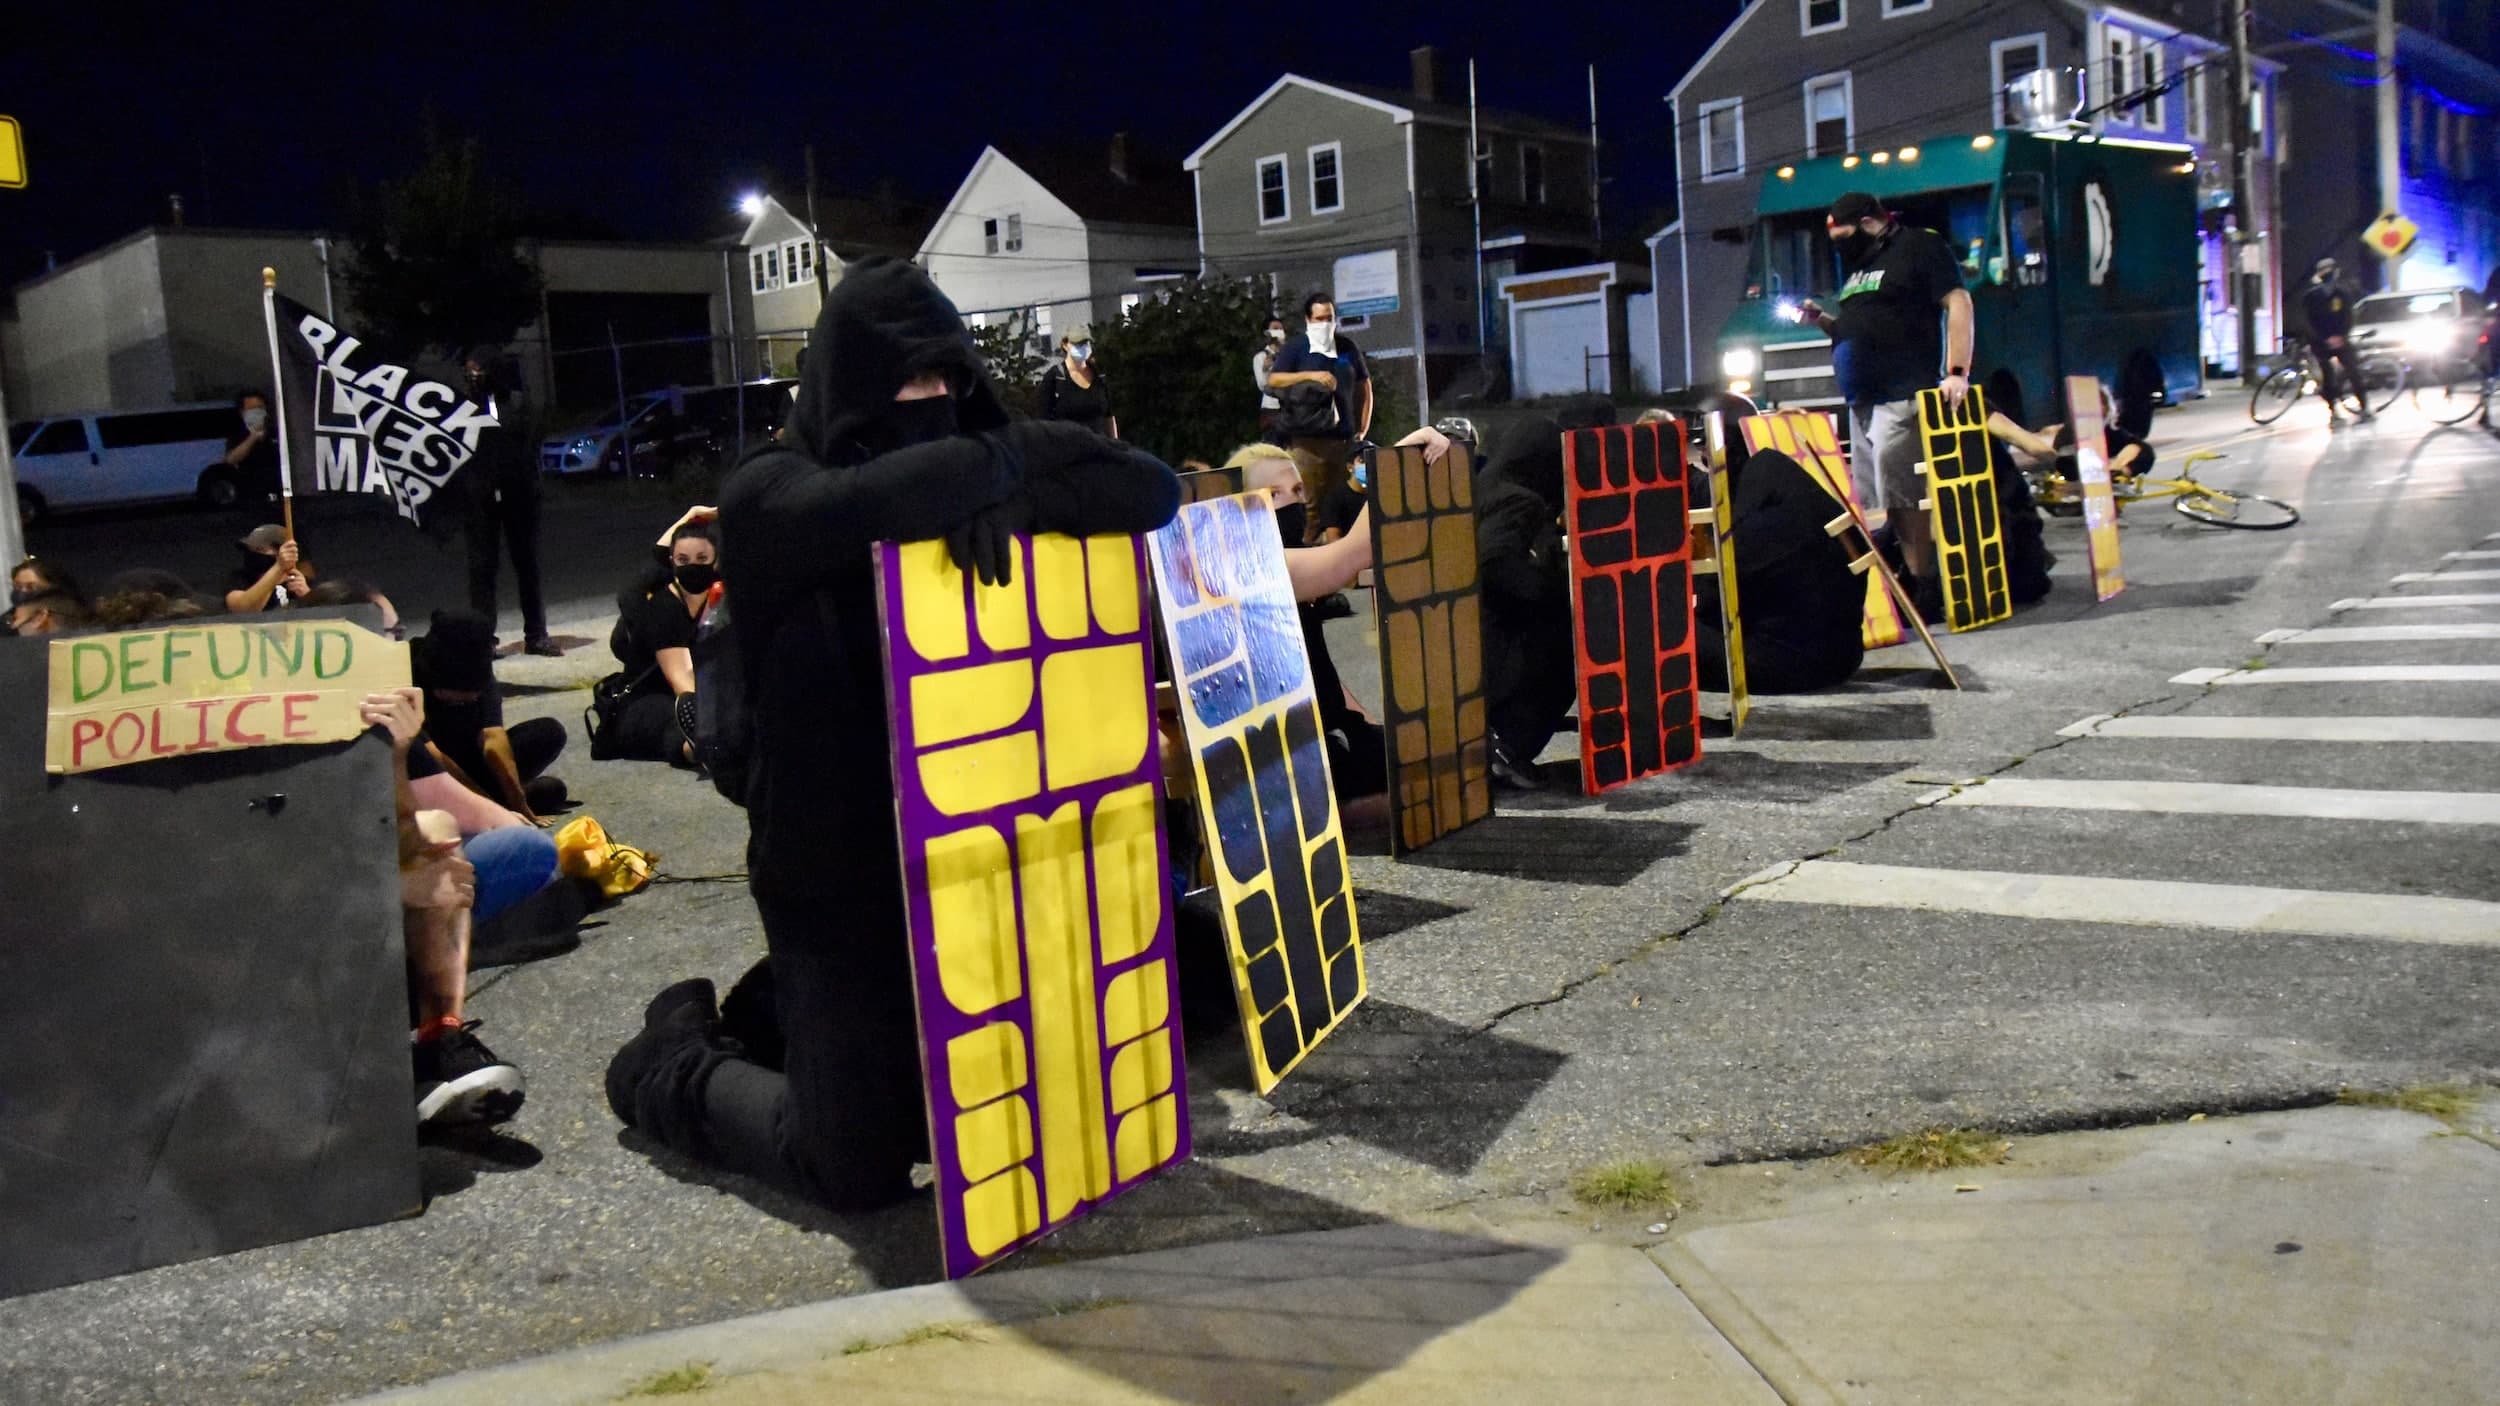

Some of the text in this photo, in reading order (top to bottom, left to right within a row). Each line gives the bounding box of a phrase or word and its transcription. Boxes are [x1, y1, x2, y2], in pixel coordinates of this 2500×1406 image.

[299, 315, 501, 452] BLACK
[72, 625, 353, 703] DEFUND
[73, 694, 320, 767] POLICE
